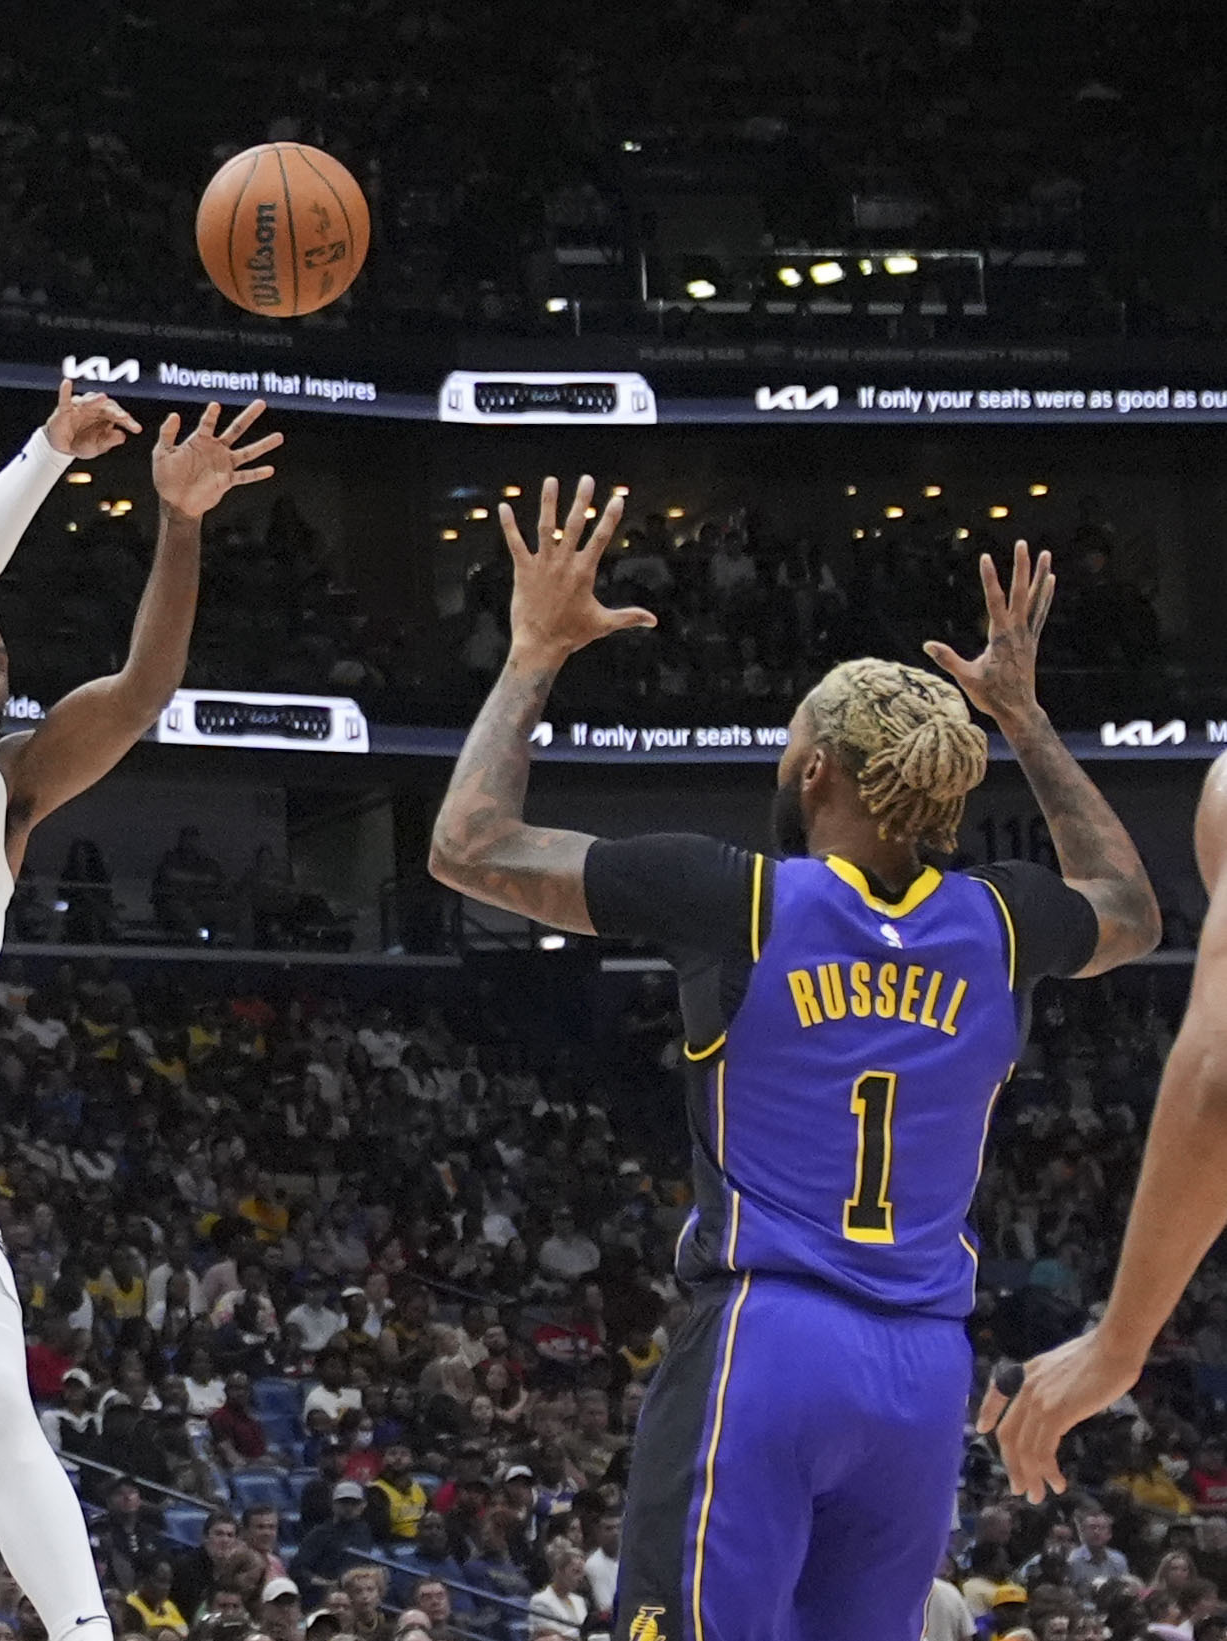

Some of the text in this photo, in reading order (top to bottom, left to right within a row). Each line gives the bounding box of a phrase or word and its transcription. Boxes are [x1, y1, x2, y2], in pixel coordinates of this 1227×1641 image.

[248, 203, 281, 306] Wilson
[159, 361, 259, 392] Movement
[264, 373, 299, 395] that
[859, 386, 875, 409] If
[878, 387, 922, 414] only
[927, 388, 973, 414] your
[978, 387, 1030, 410] seats
[1035, 390, 1085, 410] were
[1090, 391, 1113, 410] as
[1117, 388, 1170, 413] good
[1173, 391, 1197, 410] as
[573, 723, 588, 746] If
[592, 724, 637, 751] only
[642, 725, 690, 751] your
[696, 727, 752, 747] seats
[755, 728, 789, 746] we
[786, 961, 968, 1037] RUSSELL
[842, 1070, 897, 1245] 1
